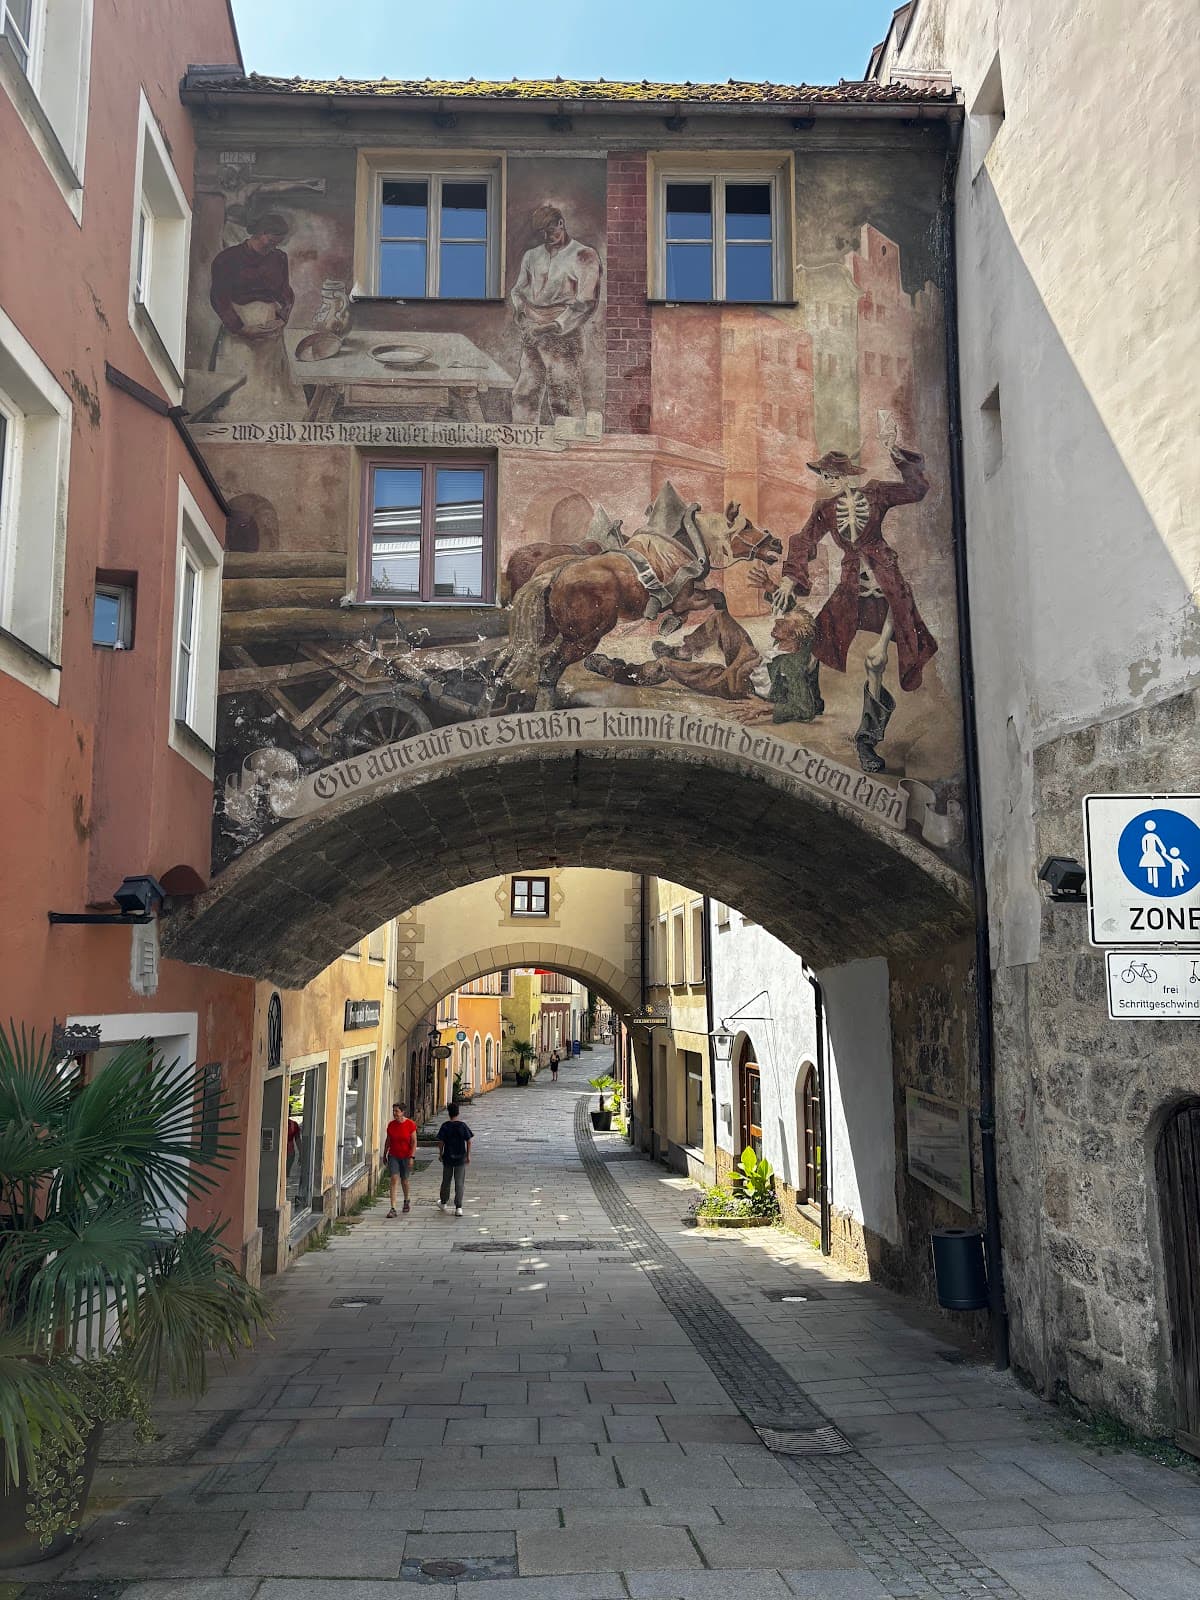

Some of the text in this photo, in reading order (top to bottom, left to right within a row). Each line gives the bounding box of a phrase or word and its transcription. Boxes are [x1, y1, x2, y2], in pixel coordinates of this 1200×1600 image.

[265, 422, 297, 443] gib
[500, 425, 545, 446] Brot
[313, 765, 362, 799] Gib
[459, 724, 493, 750] die
[679, 714, 736, 749] leicht
[738, 727, 785, 766] dein
[785, 748, 851, 795] Leben
[1129, 907, 1200, 930] ZONE
[1163, 985, 1179, 994] frei
